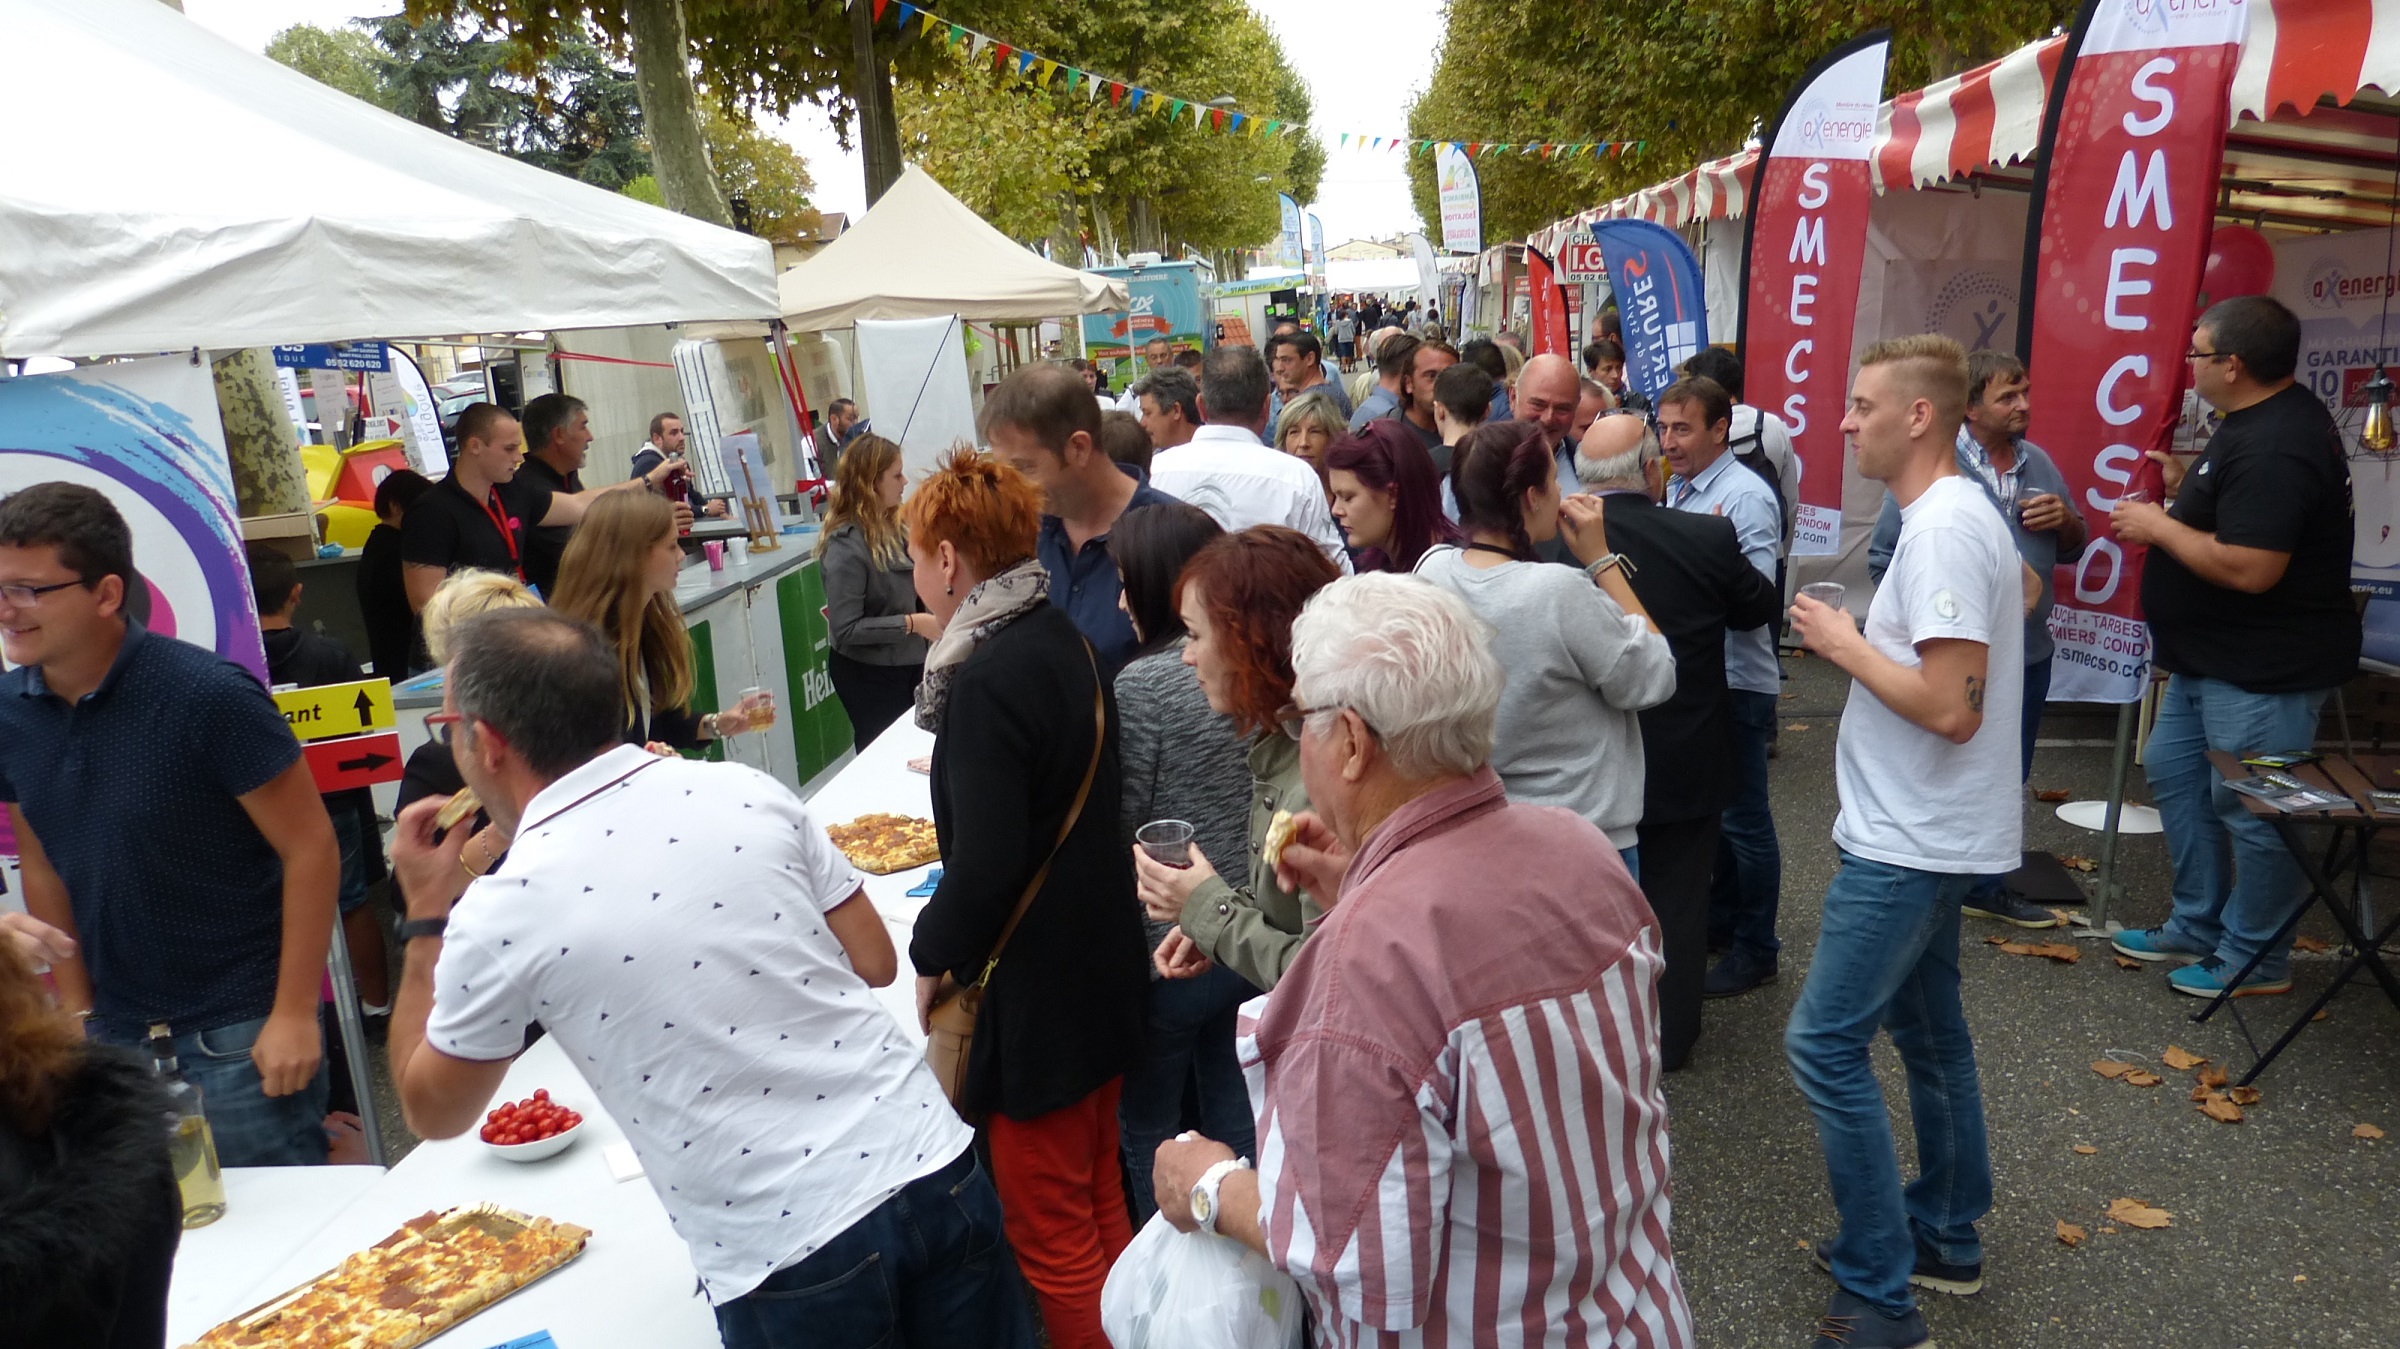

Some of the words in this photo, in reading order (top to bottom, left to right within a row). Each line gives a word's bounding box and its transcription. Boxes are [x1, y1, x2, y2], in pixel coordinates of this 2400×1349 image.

[1570, 273, 1581, 281] 05
[1584, 273, 1595, 281] 62
[2076, 57, 2176, 605] SMECSO
[325, 358, 337, 367] 05
[349, 359, 365, 368] 620
[365, 360, 382, 369] 620
[2308, 370, 2339, 397] 10
[2091, 614, 2143, 639] TARBES
